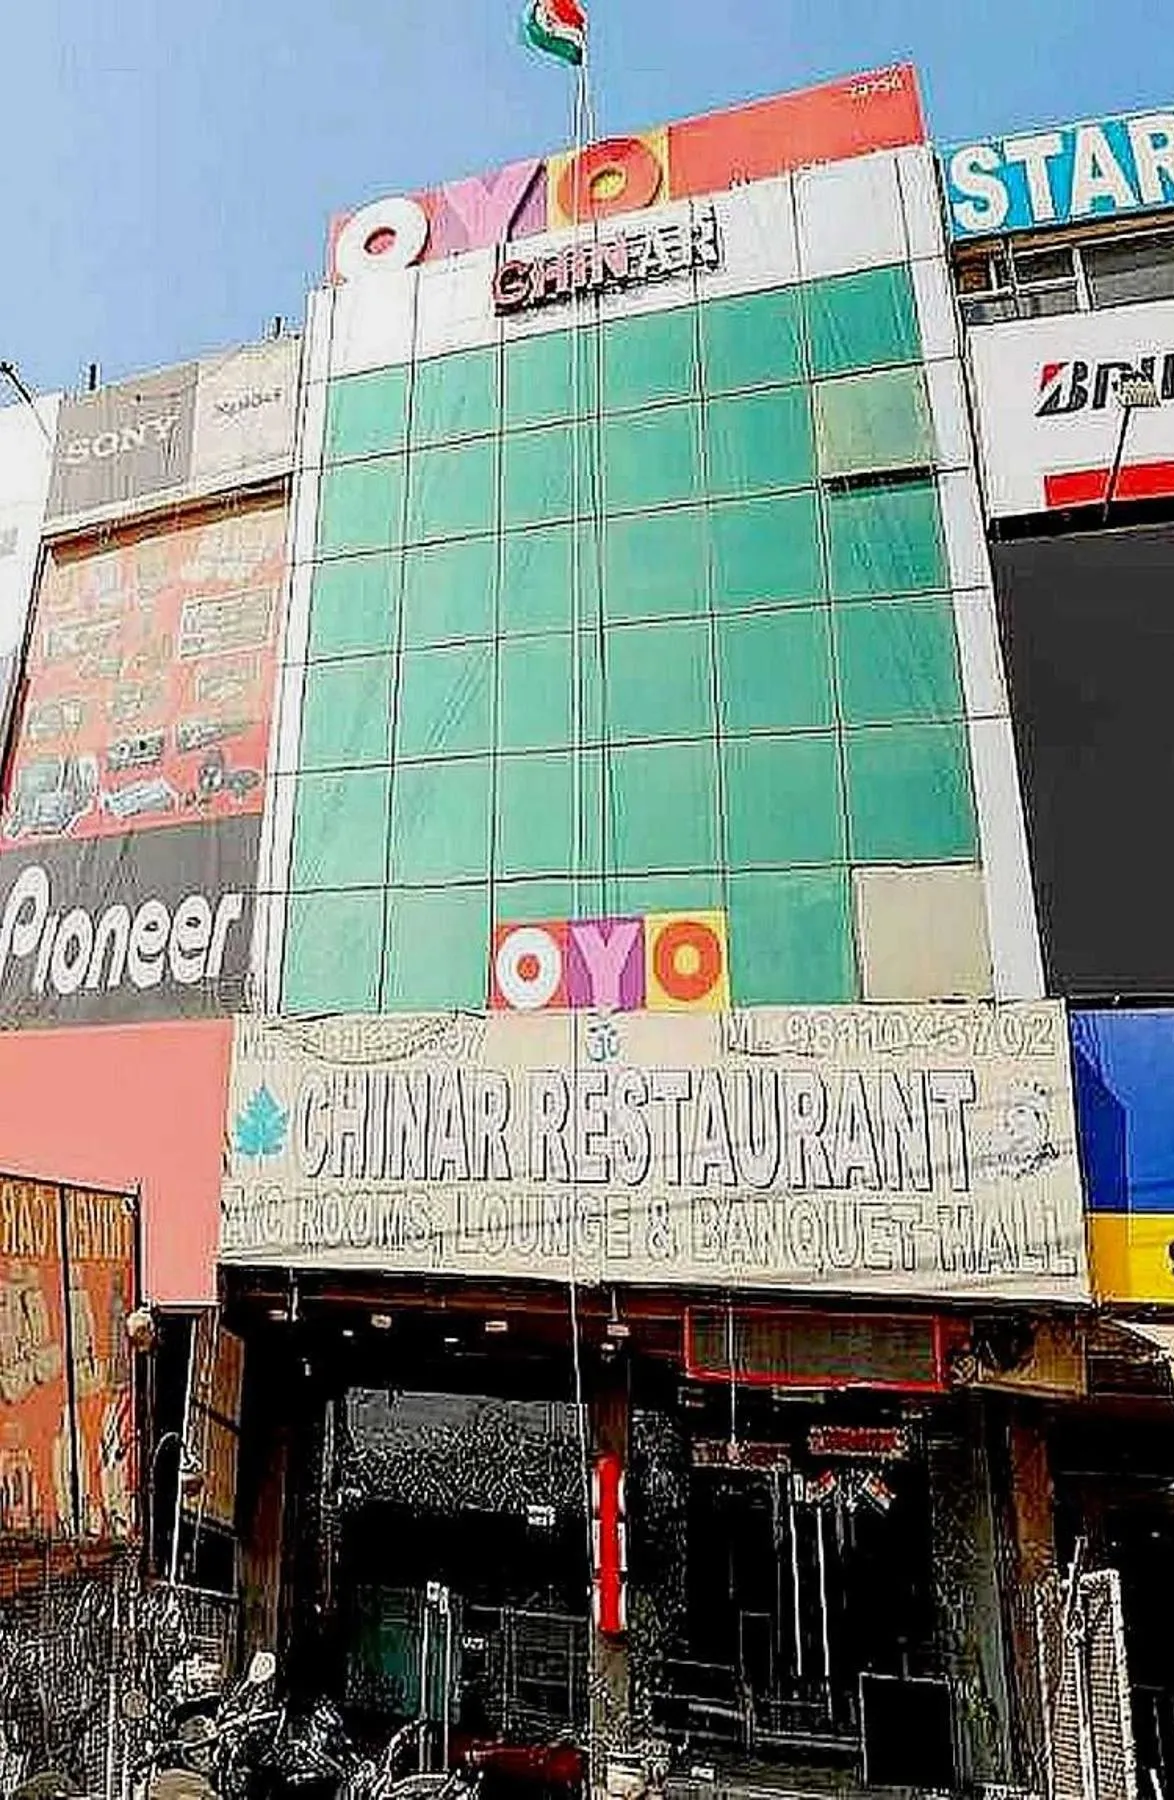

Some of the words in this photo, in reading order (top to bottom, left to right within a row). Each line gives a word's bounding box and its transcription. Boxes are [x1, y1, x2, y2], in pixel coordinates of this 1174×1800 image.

[335, 138, 664, 284] OYO
[59, 411, 181, 465] SONY
[0, 864, 245, 996] Pioneer
[497, 920, 723, 1009] OYO
[300, 1069, 511, 1182] CHINAR
[531, 1069, 978, 1192] RESTAURANT
[453, 1192, 632, 1261] LOUNGE
[646, 1198, 678, 1260] &
